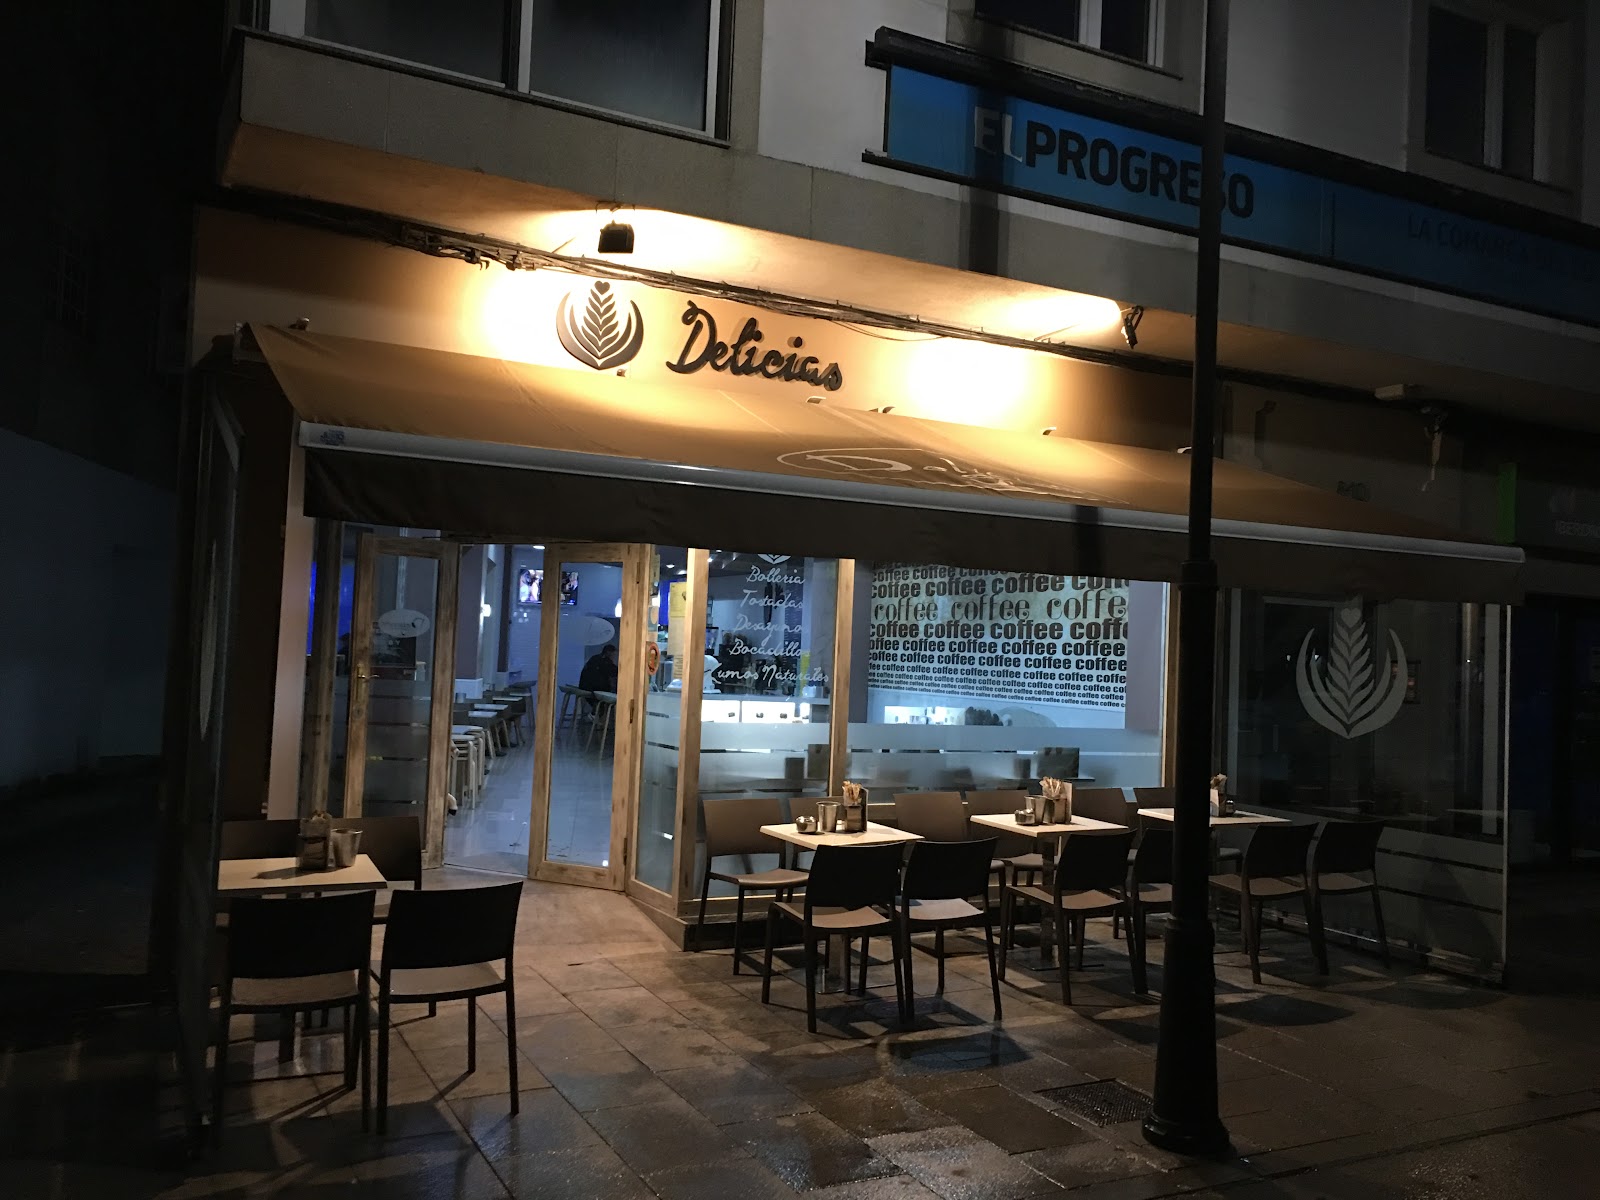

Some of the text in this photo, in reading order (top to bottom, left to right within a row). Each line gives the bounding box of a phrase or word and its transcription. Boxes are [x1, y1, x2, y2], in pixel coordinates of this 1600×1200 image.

[974, 104, 1255, 219] EL PROGREO
[666, 300, 843, 391] Delicias
[913, 565, 956, 580] coffee
[925, 577, 987, 597] coffee
[991, 573, 1065, 594] coffee
[874, 588, 1127, 621] coffee coffee coffe
[924, 620, 985, 639] coffee
[990, 620, 1064, 640] coffee
[902, 639, 945, 652] coffee
[949, 640, 998, 654] coffee
[1001, 641, 1057, 655] coffee
[1061, 641, 1125, 657] coffee
[900, 652, 934, 664] coffee
[937, 653, 976, 665] coffee
[978, 655, 1021, 667] coffee
[1024, 656, 1072, 669] coffee
[1075, 657, 1126, 671] coffee
[882, 663, 905, 672] coffee
[906, 664, 931, 673] coffee
[932, 666, 959, 675] coffee
[960, 667, 988, 676] coffee
[990, 668, 1020, 678] coffee
[1023, 670, 1055, 680] coffee
[1058, 671, 1093, 682] coffee
[934, 675, 954, 683] coffee
[956, 676, 977, 684] coffee
[978, 678, 1001, 686] coffee
[1002, 679, 1025, 687] coffee
[1027, 680, 1052, 689] coffee
[1054, 682, 1081, 690] coffee
[1082, 683, 1110, 692] coffee
